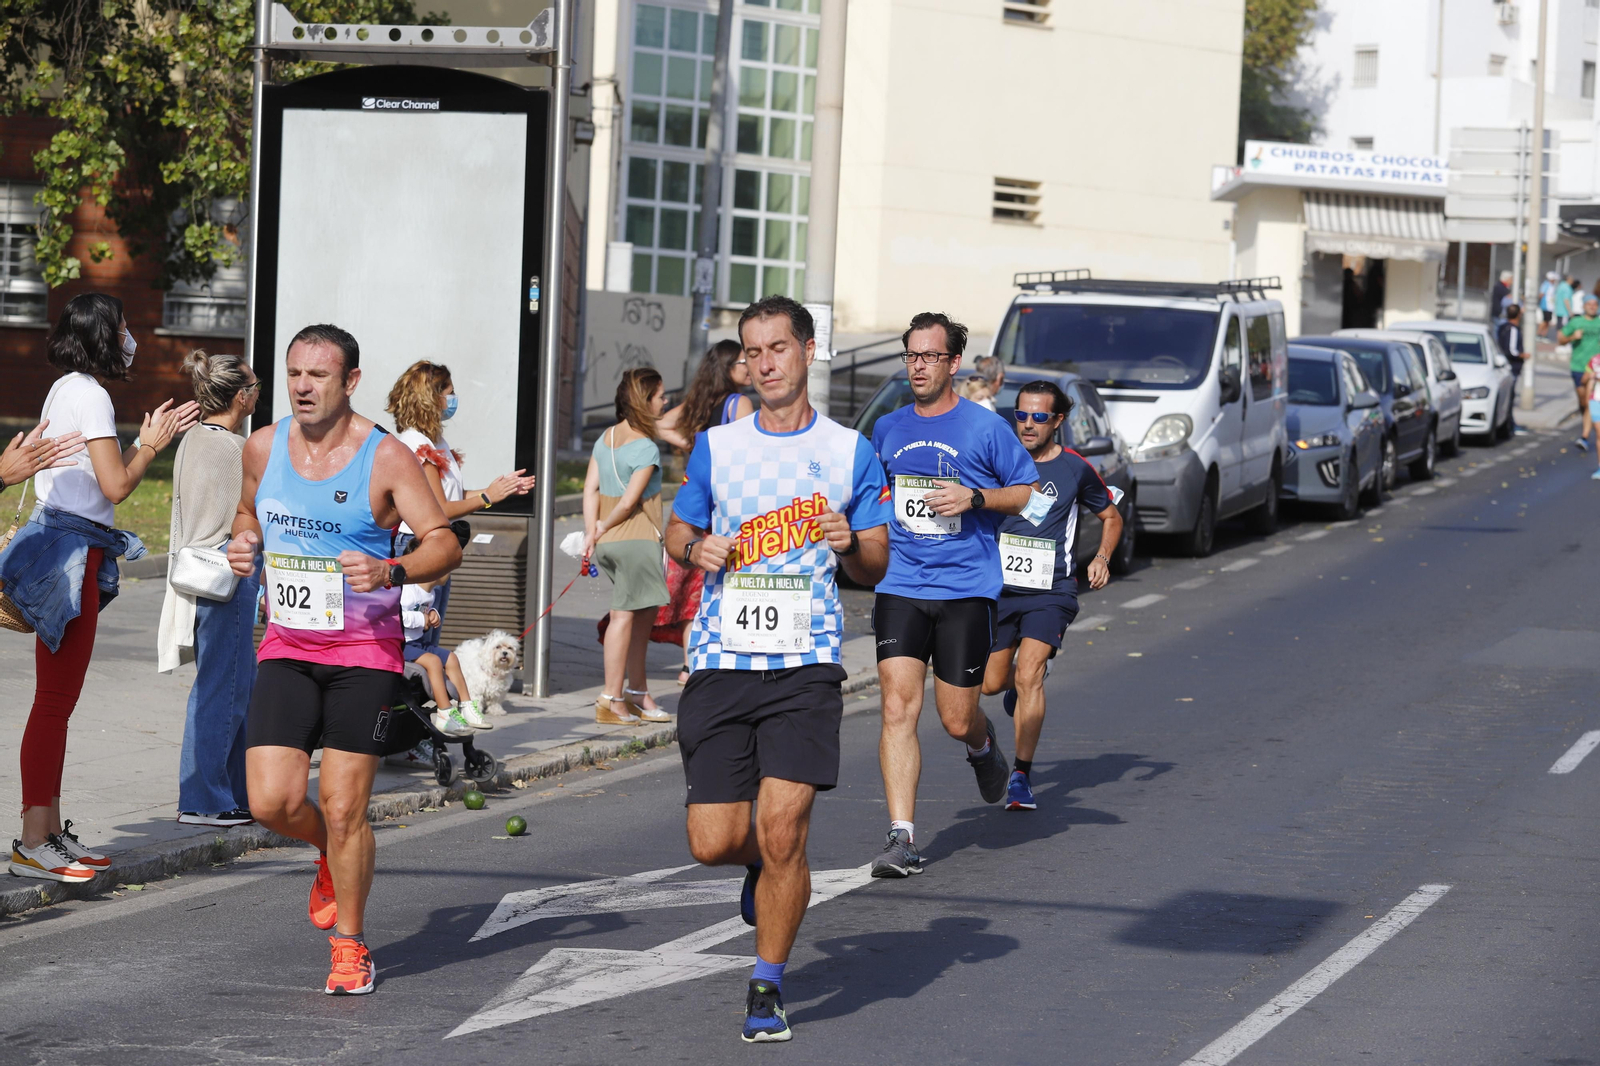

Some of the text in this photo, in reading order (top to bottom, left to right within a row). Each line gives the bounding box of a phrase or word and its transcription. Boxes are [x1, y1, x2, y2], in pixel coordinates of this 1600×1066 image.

[376, 99, 440, 110] Clear Channel
[1270, 147, 1354, 163] CHURROS
[1294, 163, 1443, 183] PATATAS FRITAS
[903, 440, 926, 452] VUELTA
[933, 441, 959, 458] HUELVA
[907, 478, 927, 487] VUELTA
[928, 479, 933, 488] A
[266, 511, 342, 534] TARTESSOS
[740, 492, 828, 539] spanish
[285, 528, 320, 540] HUELVA
[1010, 537, 1027, 547] VUELTA
[1033, 540, 1052, 550] HUELVA
[275, 557, 299, 570] VUELTA
[300, 560, 306, 570] A
[308, 560, 336, 572] HUELVA
[1005, 555, 1033, 574] 223
[286, 571, 309, 579] MIGUEL
[729, 577, 804, 589] 34 VUELTA A HUELVA
[276, 582, 311, 609] 302
[736, 605, 779, 631] 419
